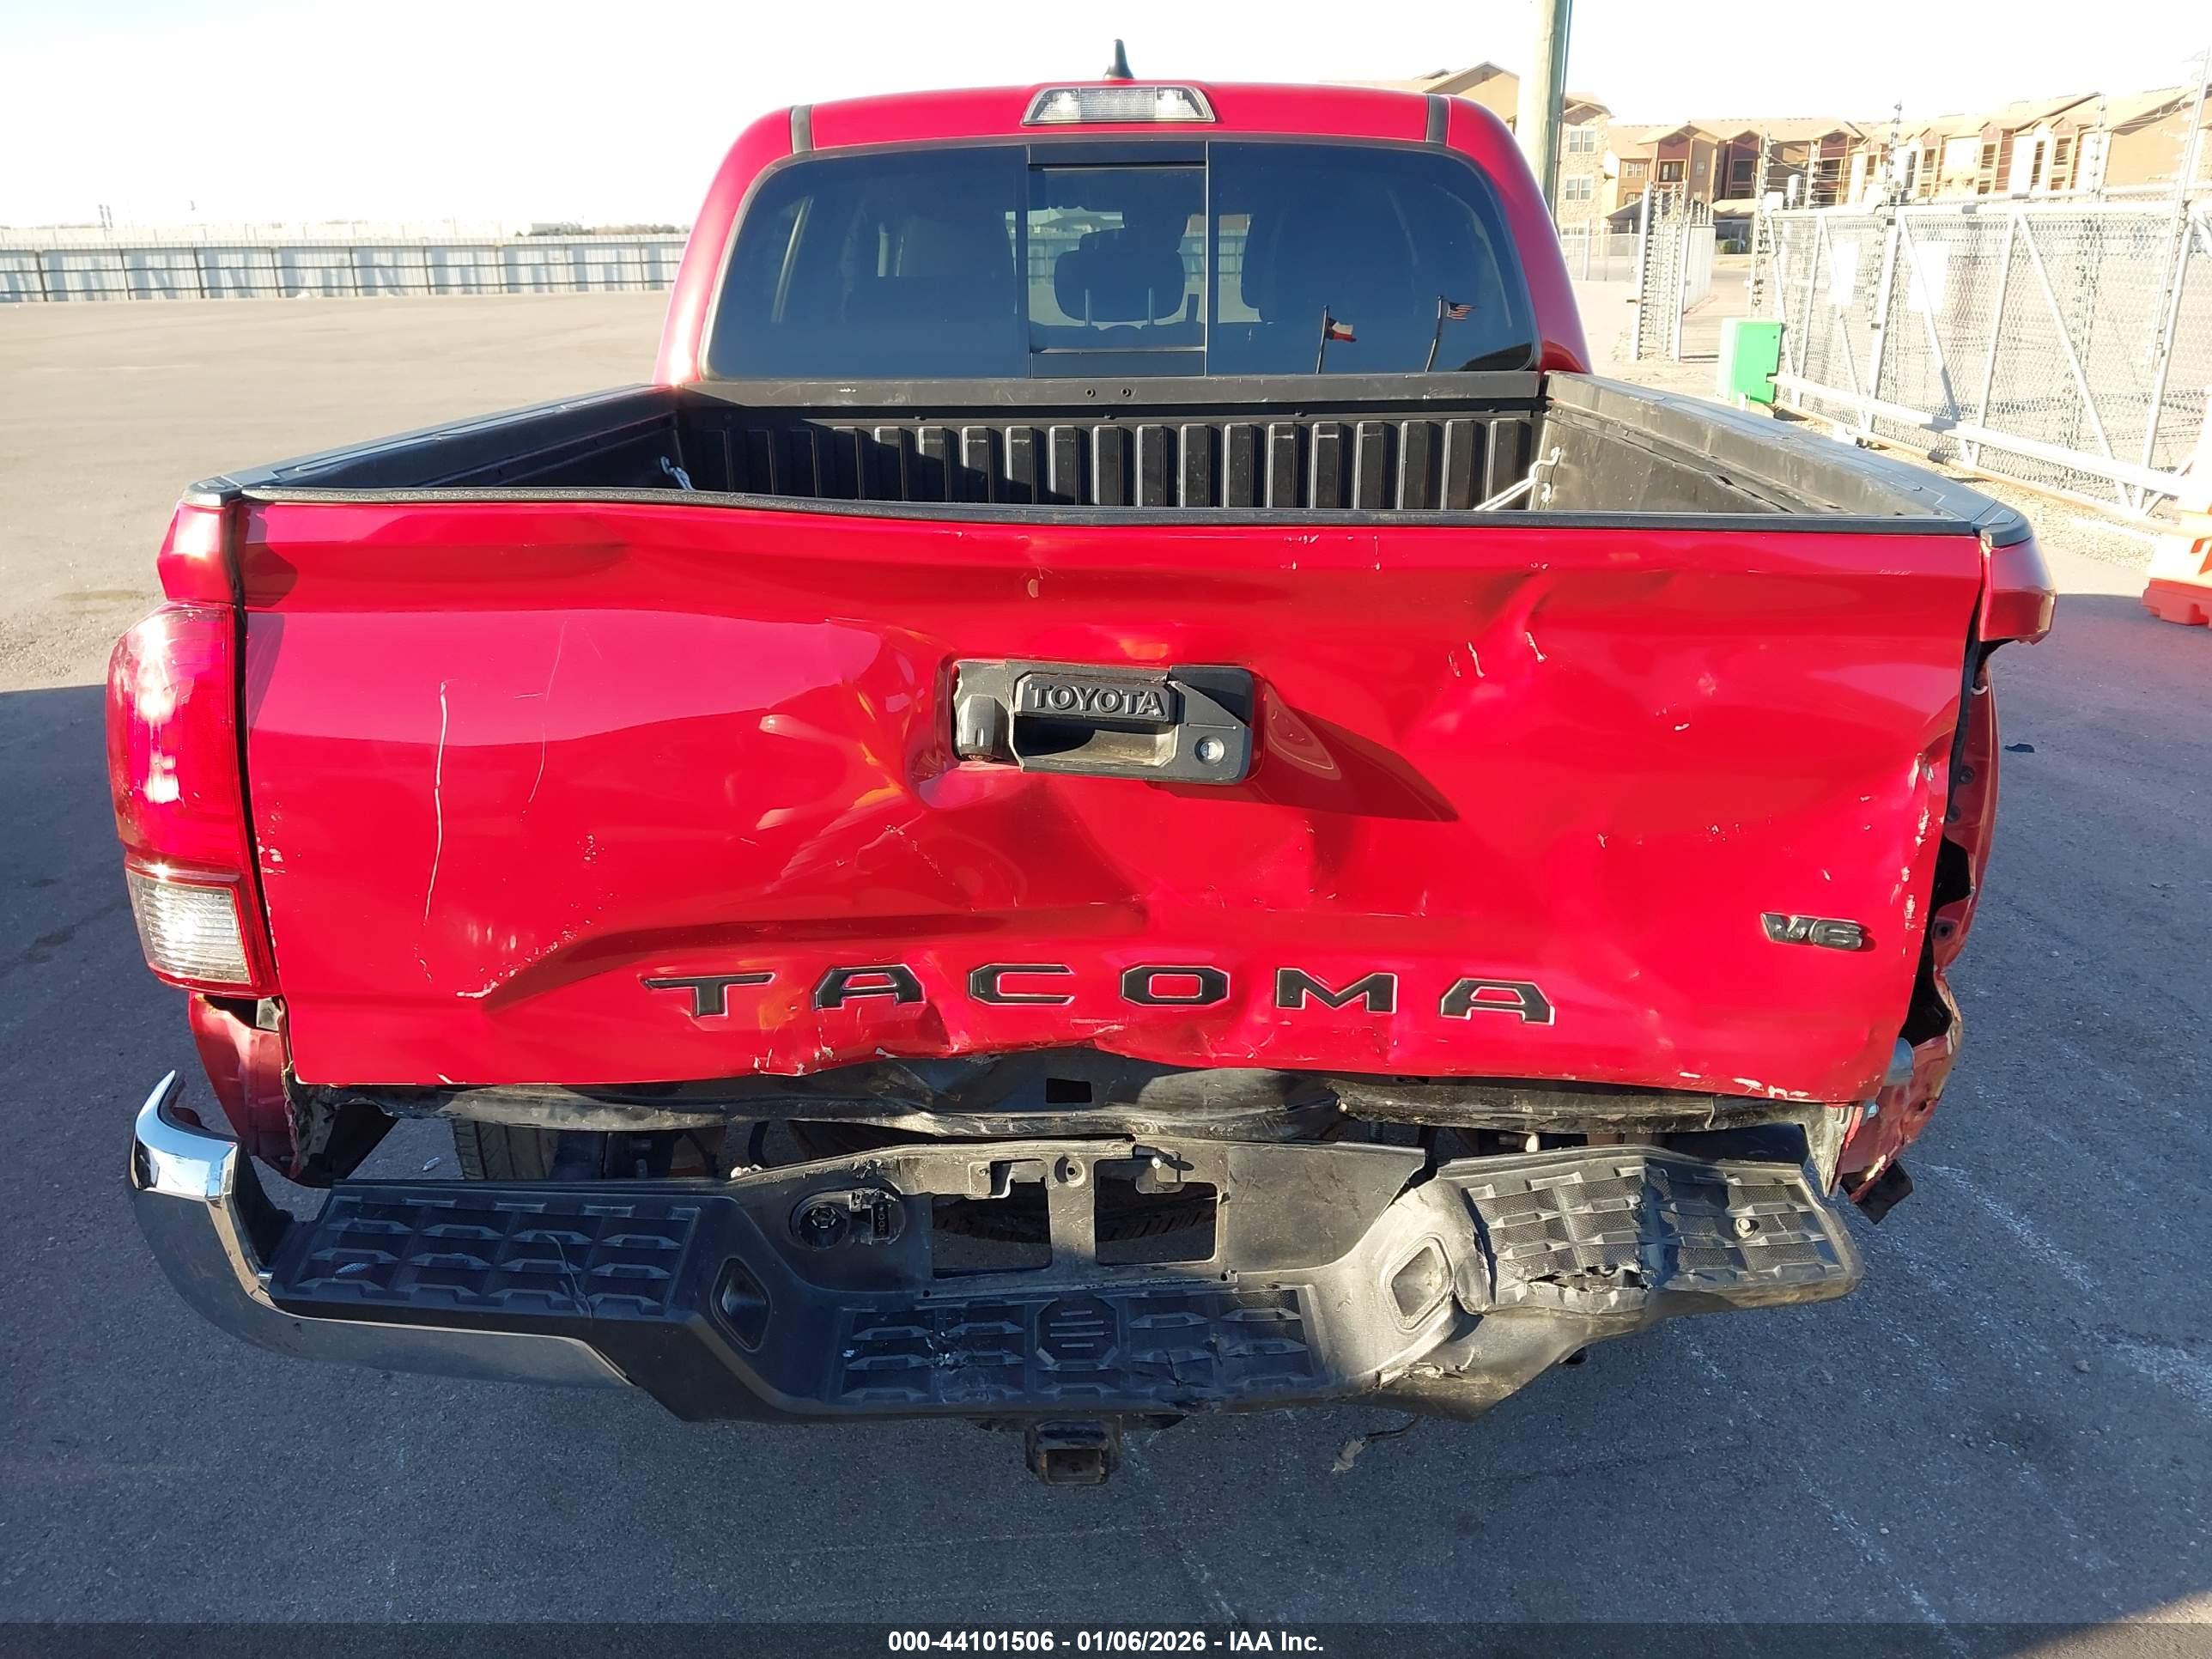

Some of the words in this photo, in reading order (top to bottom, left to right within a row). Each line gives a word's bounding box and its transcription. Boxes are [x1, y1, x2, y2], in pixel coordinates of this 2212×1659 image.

[1030, 684, 1166, 716] TOYOTA
[1760, 912, 1863, 951] V6
[640, 963, 1556, 1026] TACOMA
